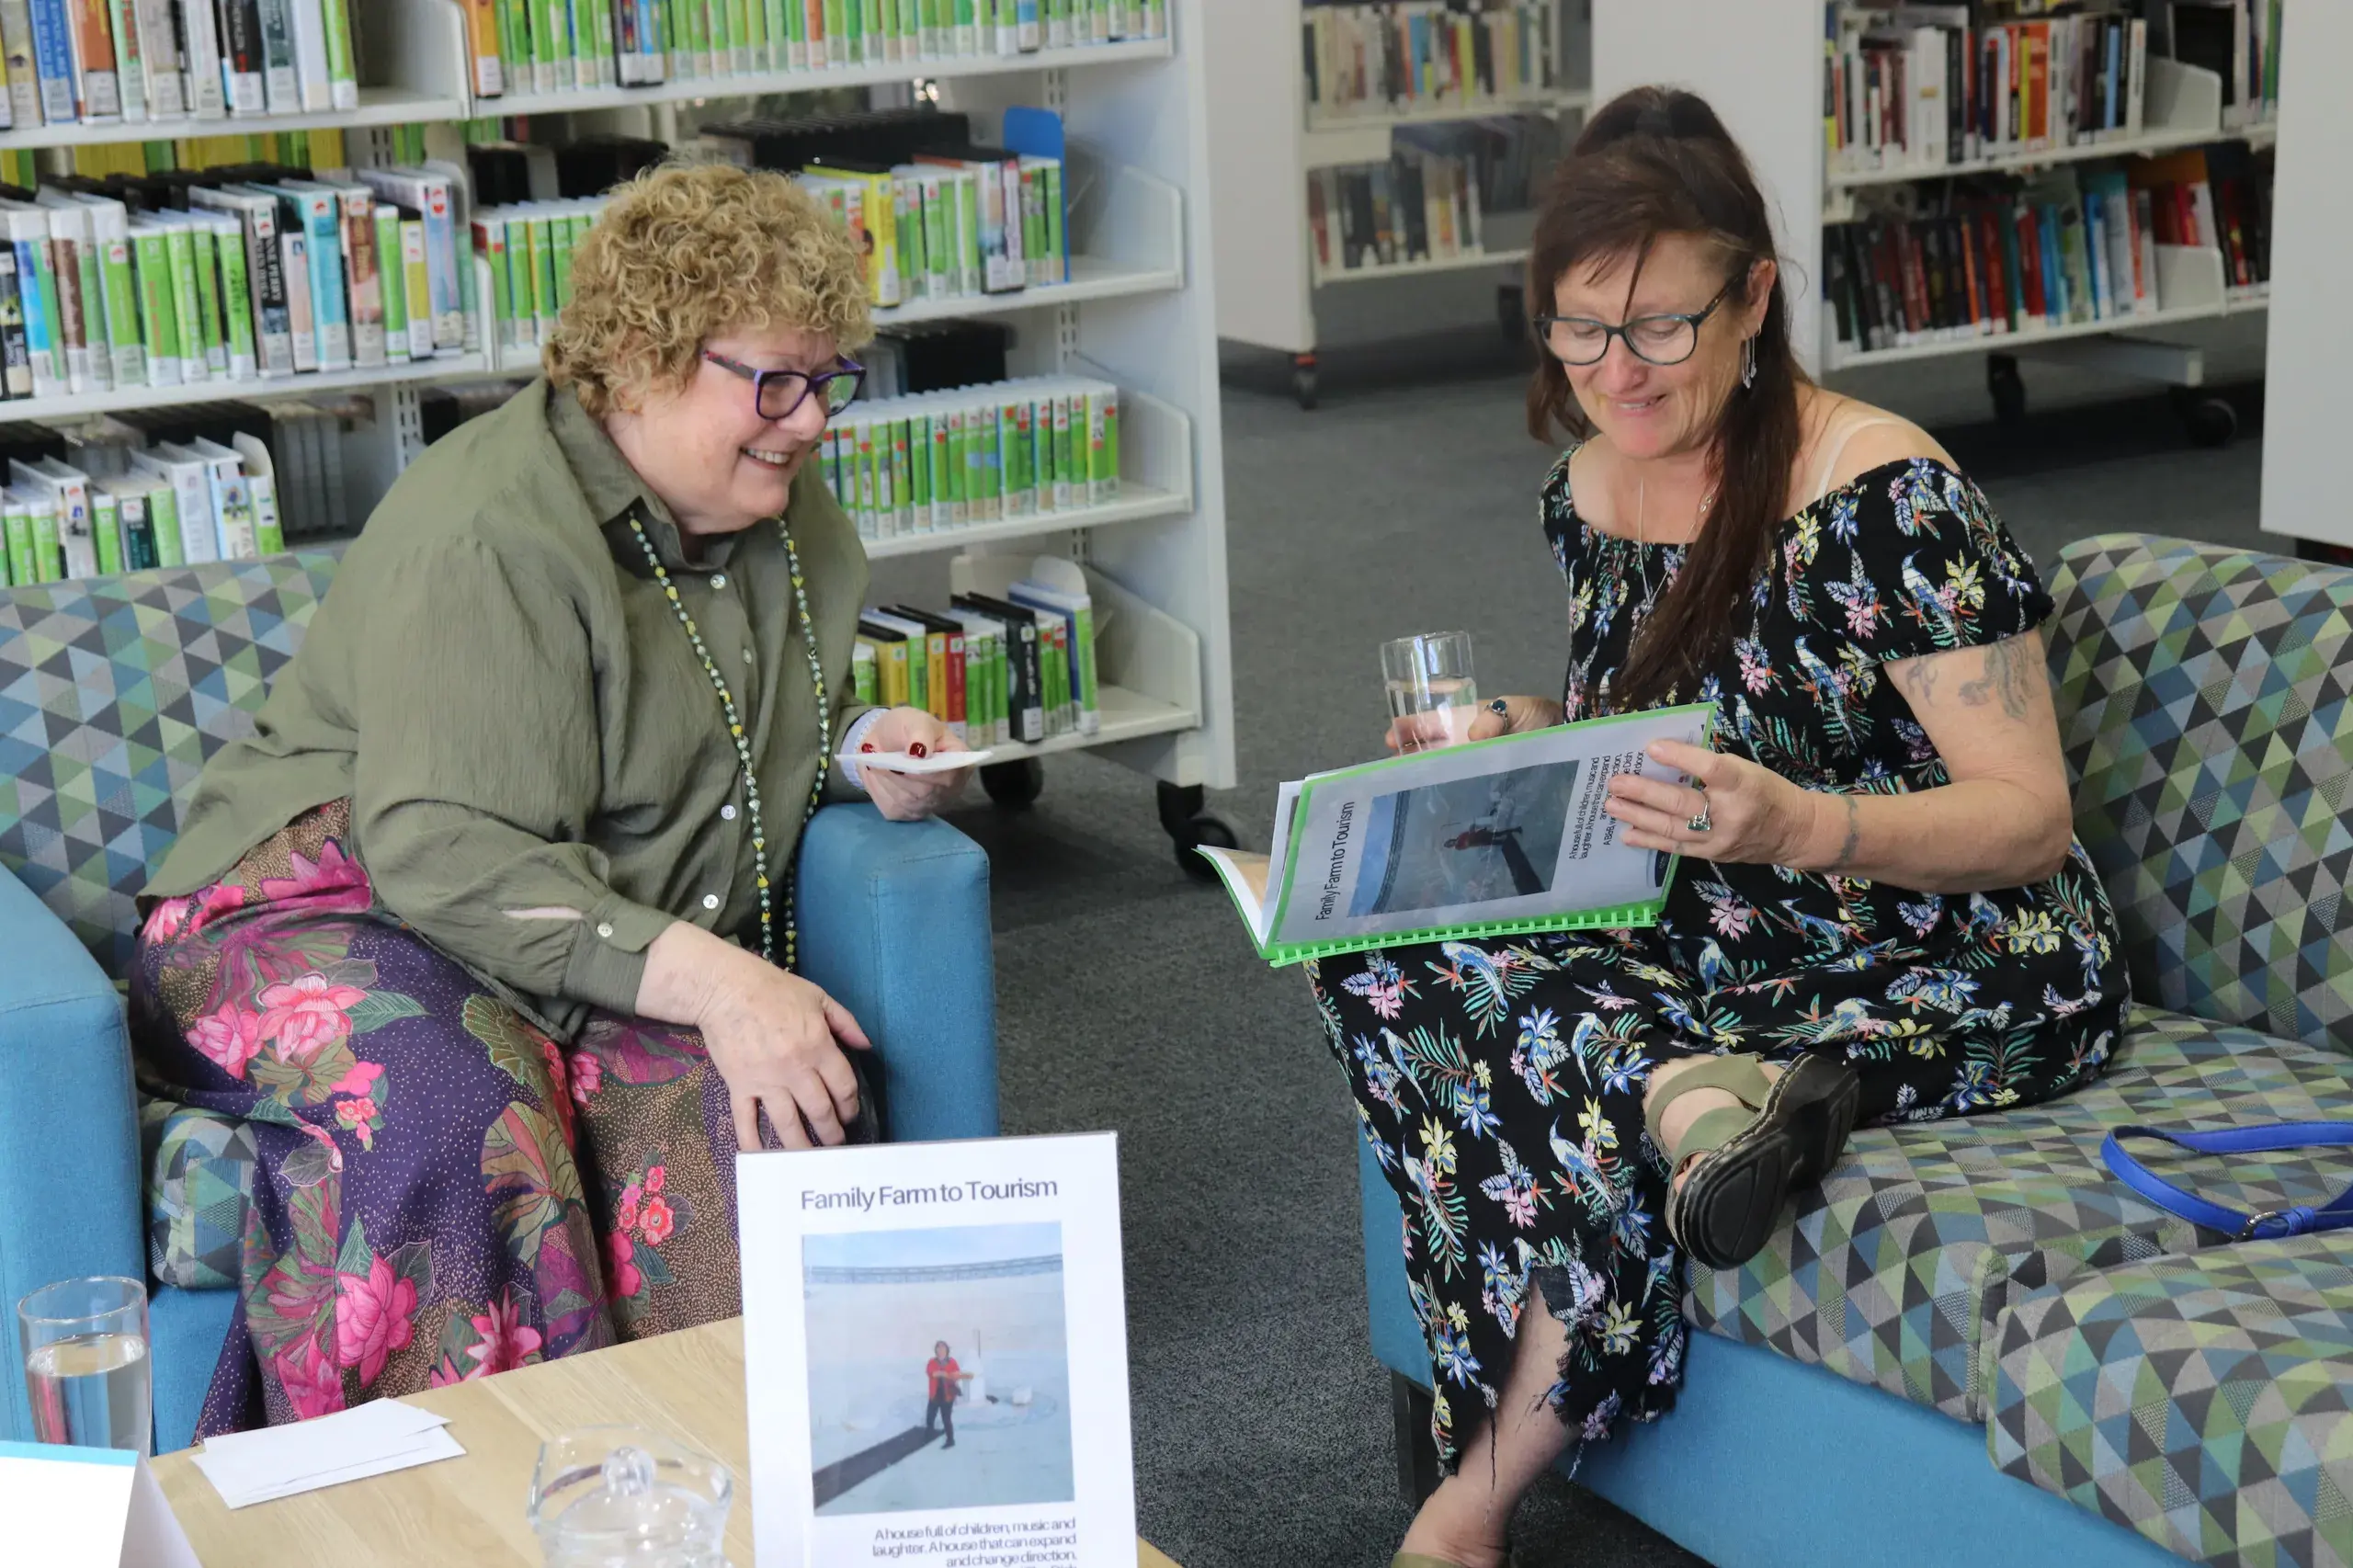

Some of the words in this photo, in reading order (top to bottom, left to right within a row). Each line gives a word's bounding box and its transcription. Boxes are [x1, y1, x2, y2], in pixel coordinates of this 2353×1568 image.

[1591, 756, 1600, 771] and
[1623, 751, 1633, 768] Dish
[1633, 749, 1645, 768] door.
[1599, 756, 1611, 781] expand
[1586, 771, 1597, 790] music
[1596, 781, 1605, 793] can
[1590, 793, 1601, 805] that
[1586, 805, 1598, 824] house
[1331, 801, 1356, 848] Tourism
[1569, 834, 1581, 855] house
[1330, 848, 1346, 861] to
[1324, 861, 1344, 890] Farm
[1314, 889, 1341, 921] Family
[801, 1187, 876, 1212] Family
[879, 1186, 938, 1206] Farm
[939, 1183, 963, 1202] to
[965, 1177, 1058, 1201] Tourism
[875, 1528, 885, 1540] A
[885, 1527, 924, 1540] house
[925, 1525, 944, 1538] full
[945, 1523, 958, 1536] of
[959, 1522, 1010, 1535] children,
[1012, 1518, 1050, 1532] music
[1051, 1516, 1076, 1530] and
[872, 1541, 928, 1559] laughter.
[928, 1541, 939, 1553] A
[939, 1540, 978, 1552] house
[979, 1538, 1004, 1551] that
[1005, 1538, 1029, 1549] can
[1029, 1533, 1076, 1550] expand
[946, 1553, 971, 1568] and
[972, 1552, 1019, 1568] change
[1020, 1549, 1077, 1563] direction.
